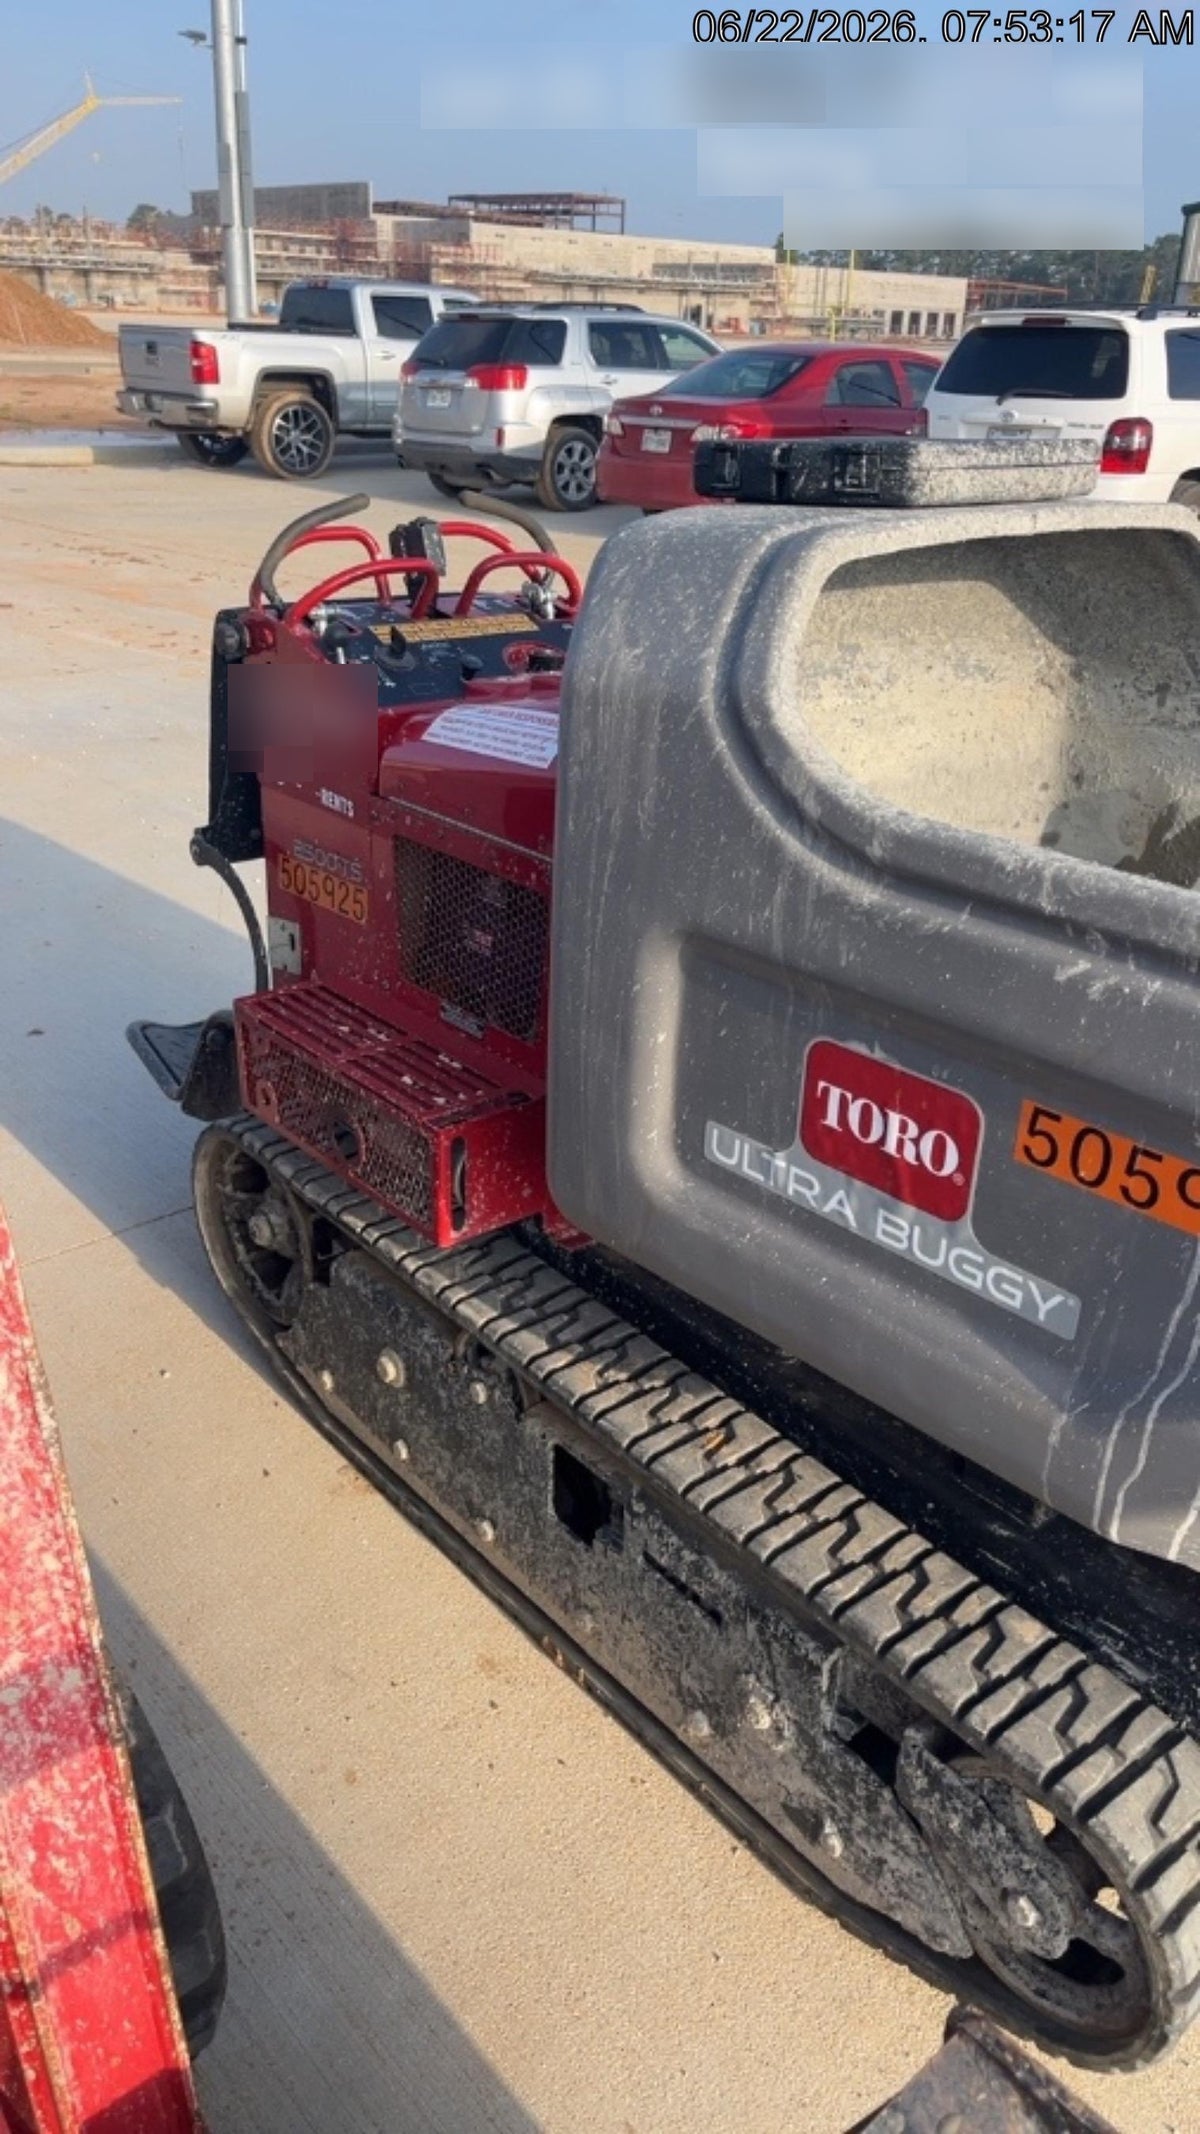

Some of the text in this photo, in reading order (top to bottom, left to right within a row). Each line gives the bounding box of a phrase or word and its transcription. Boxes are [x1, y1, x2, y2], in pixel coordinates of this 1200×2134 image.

[281, 856, 364, 921] 505925
[817, 1080, 960, 1179] TORO
[711, 1128, 1064, 1322] ULTRA BUGGY
